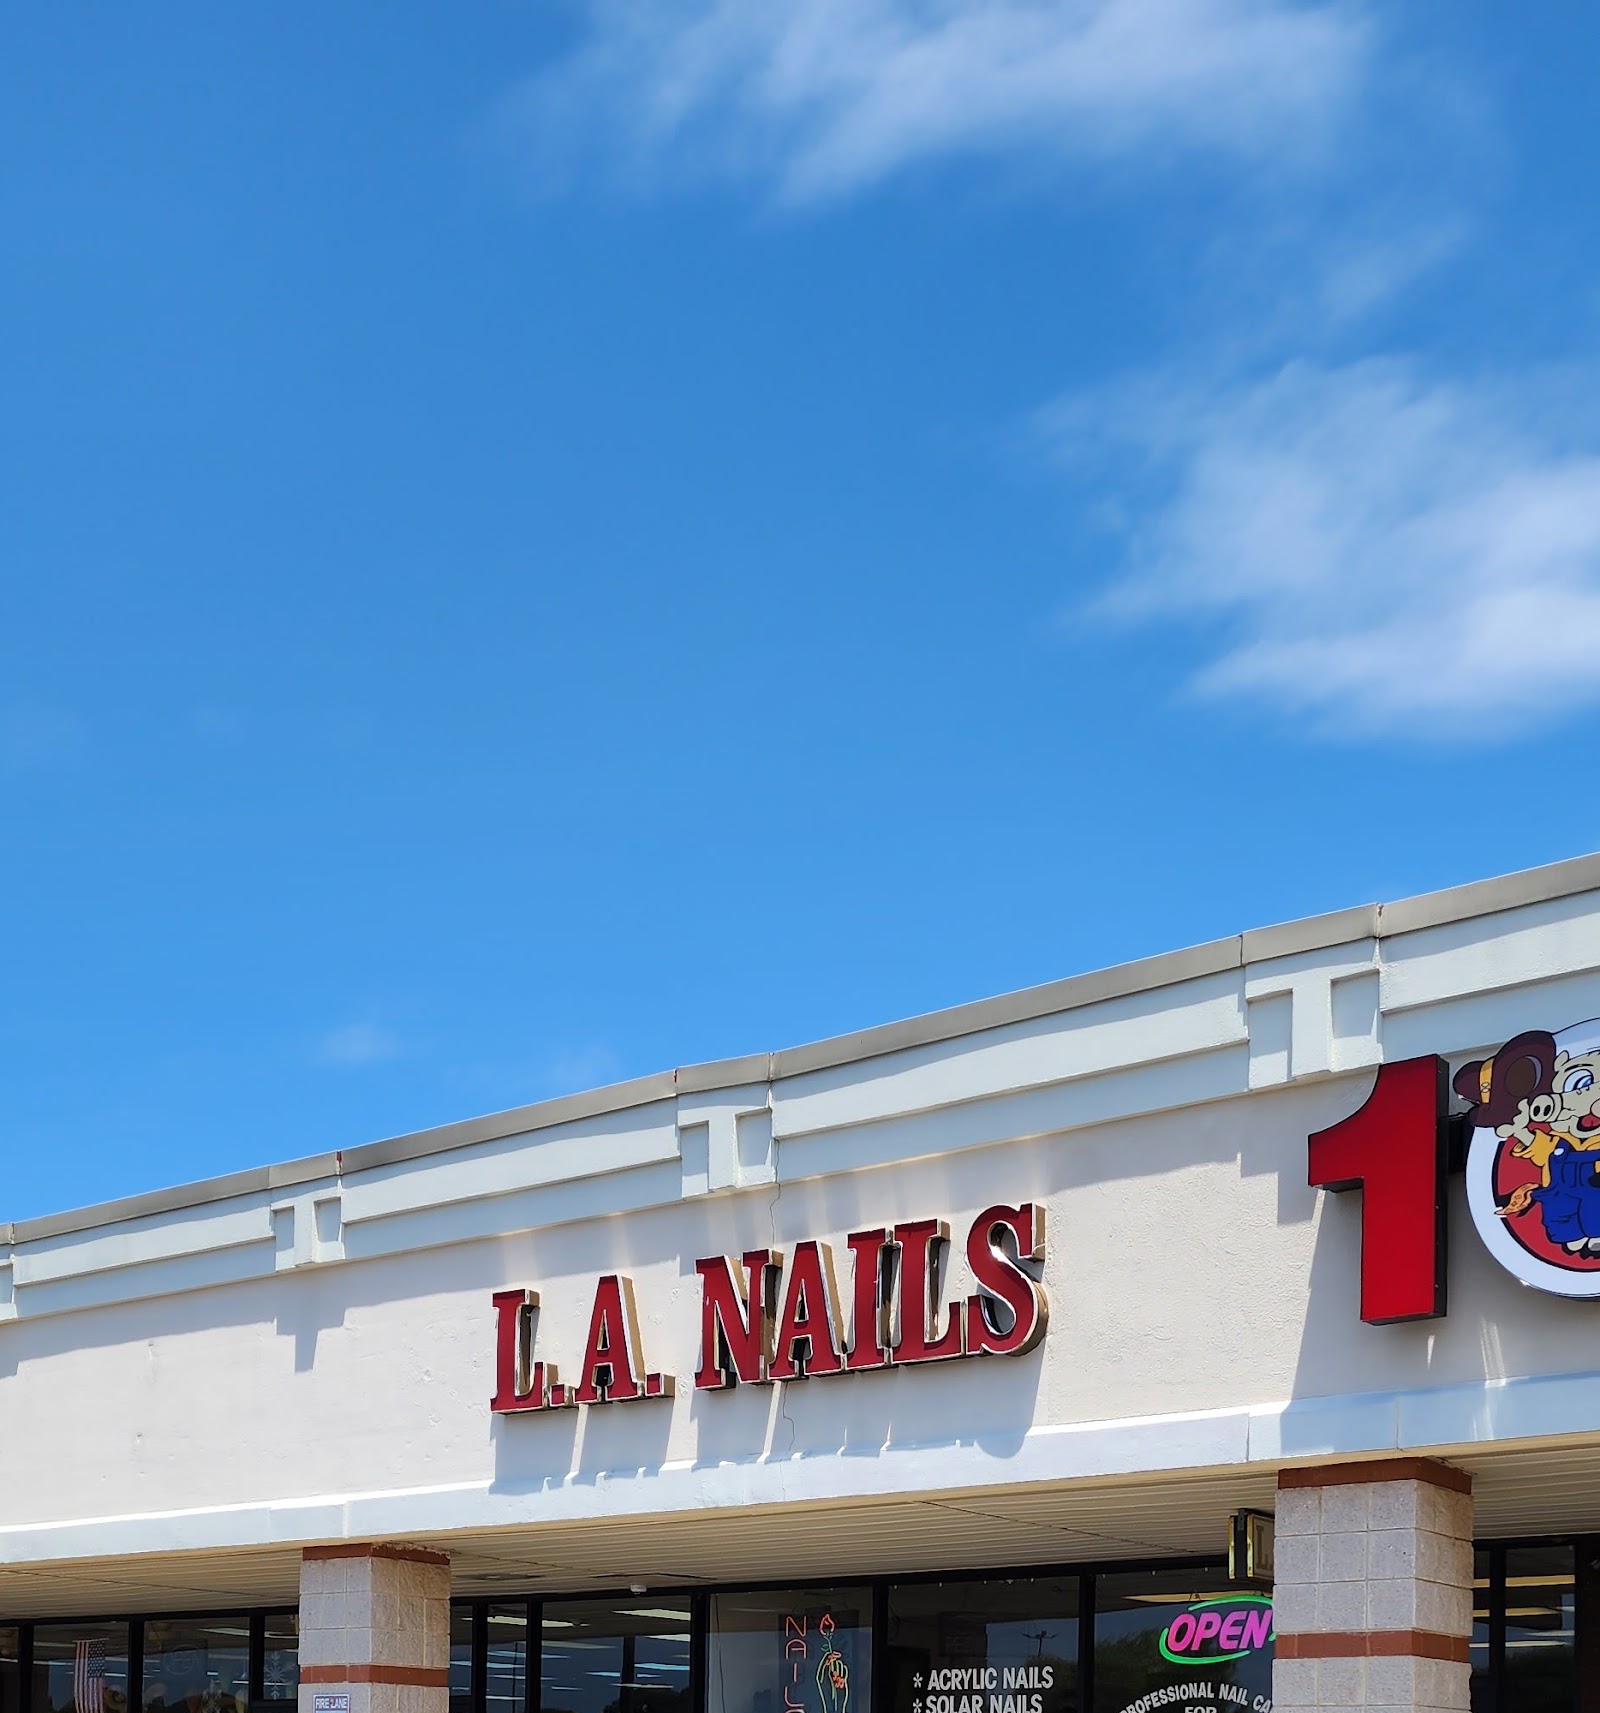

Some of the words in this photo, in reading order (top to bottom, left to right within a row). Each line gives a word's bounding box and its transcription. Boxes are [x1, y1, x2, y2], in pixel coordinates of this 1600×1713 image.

[490, 1274, 674, 1414] L.A.
[695, 1202, 1048, 1392] NAILS
[1168, 1609, 1273, 1652] OPEN
[927, 1667, 998, 1691] ACRYLIC
[1003, 1665, 1054, 1689] NAILS
[315, 1698, 330, 1709] FIRE
[1218, 1683, 1249, 1706] NAIL
